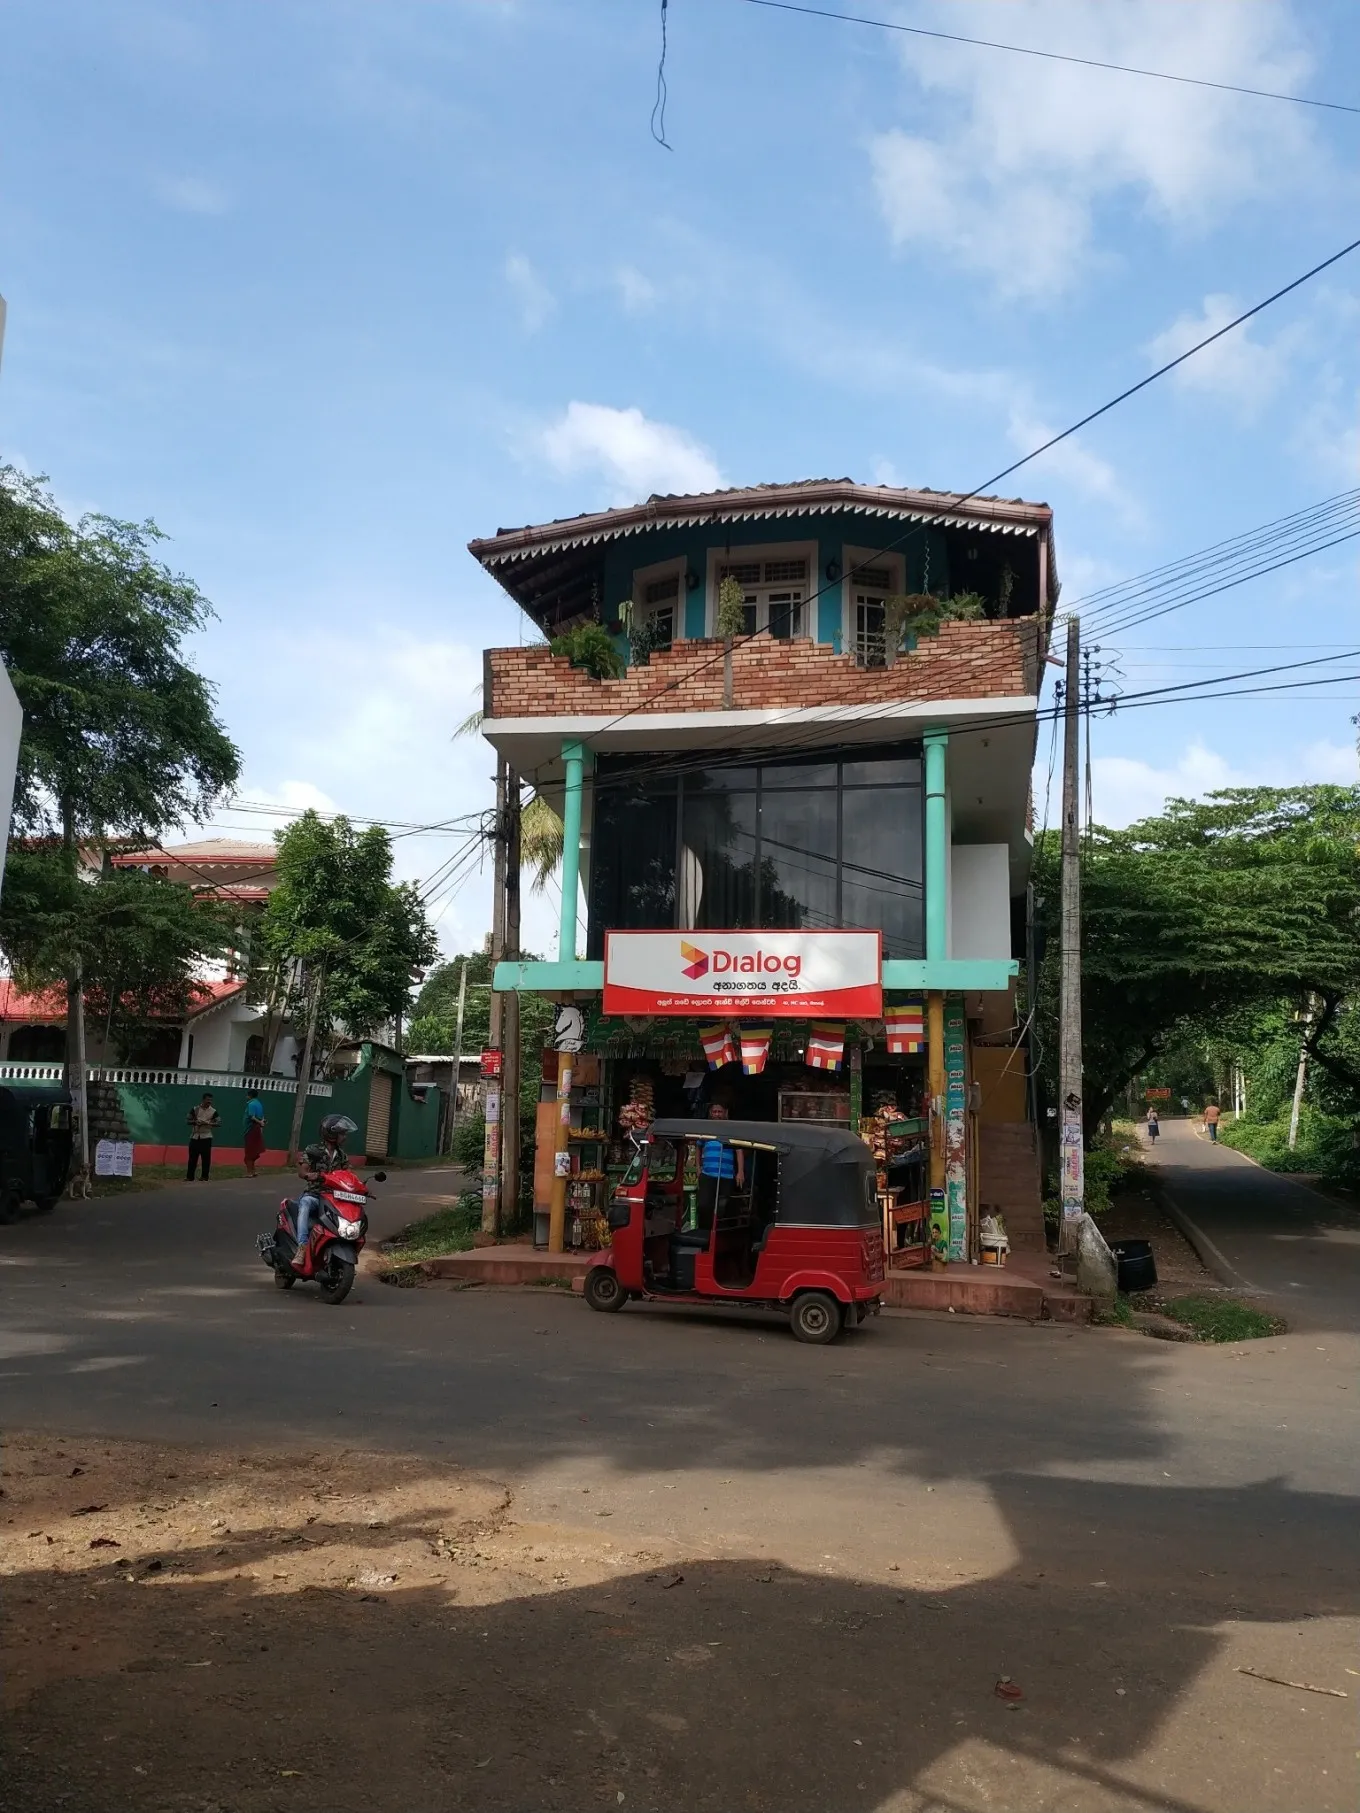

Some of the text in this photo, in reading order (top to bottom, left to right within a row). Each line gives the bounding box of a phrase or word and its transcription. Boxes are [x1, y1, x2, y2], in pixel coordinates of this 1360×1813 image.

[712, 950, 801, 977] Dialog
[713, 980, 801, 993] අනාගතය අදයි.
